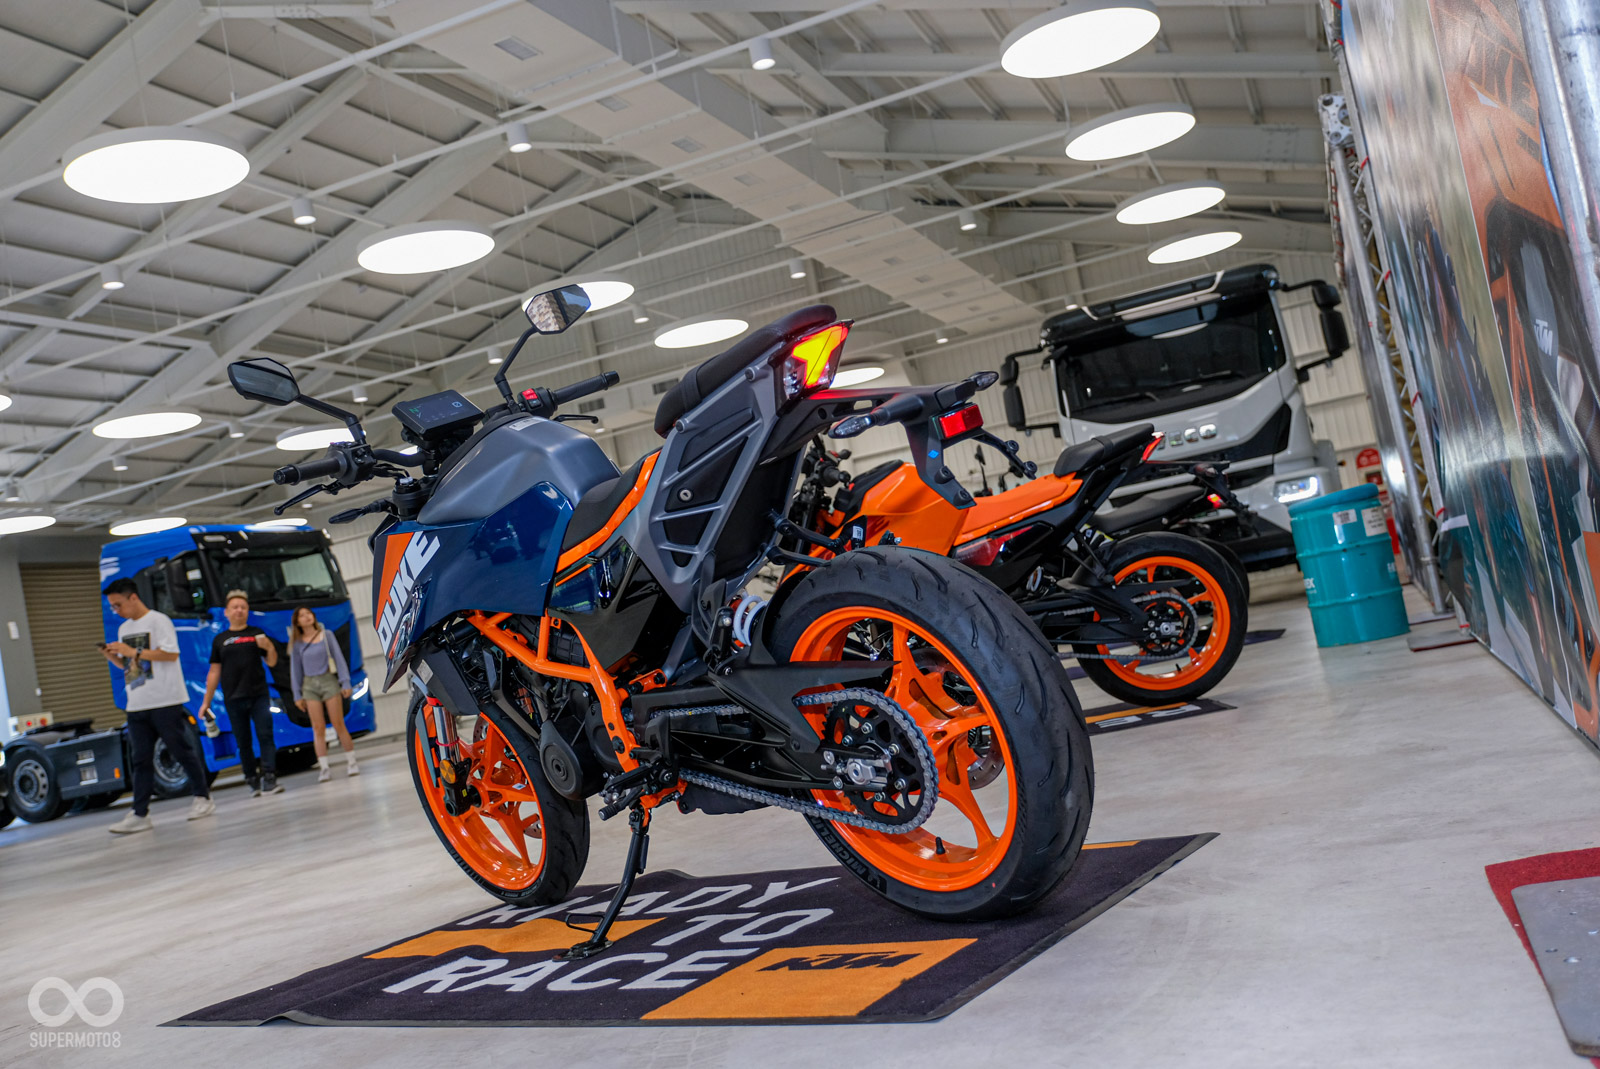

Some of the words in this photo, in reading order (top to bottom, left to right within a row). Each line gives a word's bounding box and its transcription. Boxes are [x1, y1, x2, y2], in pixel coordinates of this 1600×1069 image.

[377, 530, 440, 654] DUKE
[652, 908, 834, 947] TO
[382, 948, 761, 993] RACE
[756, 951, 924, 972] KTM
